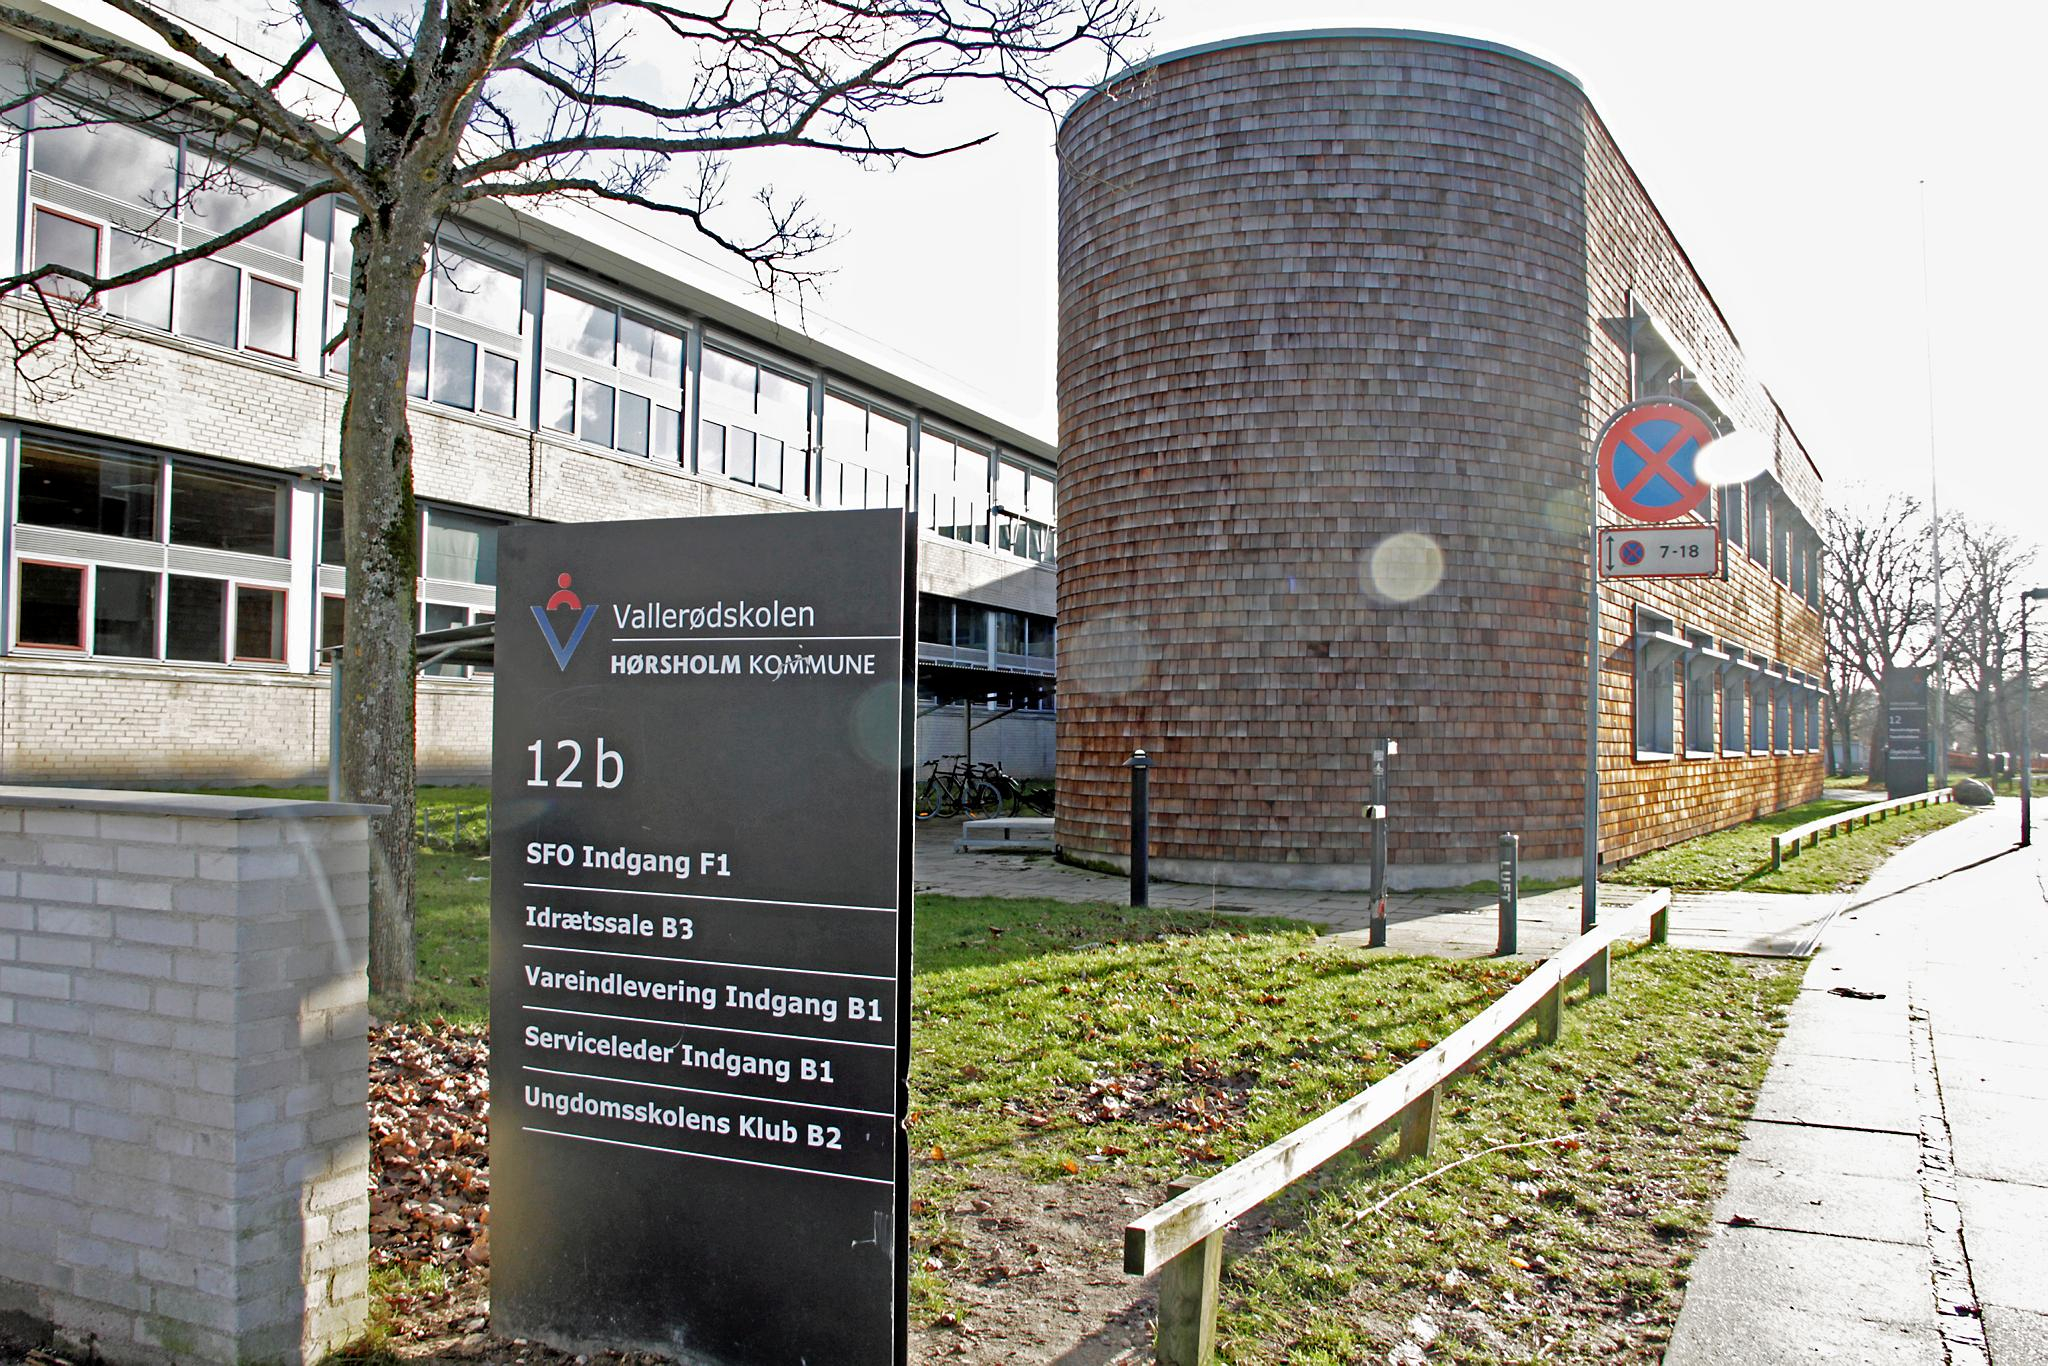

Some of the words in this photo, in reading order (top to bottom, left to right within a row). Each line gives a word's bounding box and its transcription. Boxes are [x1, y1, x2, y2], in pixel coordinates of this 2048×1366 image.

[1659, 544, 1700, 559] 7-18
[612, 600, 815, 630] Vallerødskolen
[610, 654, 742, 676] HØRSHOLM
[749, 653, 876, 675] KOMMUNE
[1889, 716, 1902, 724] 12
[526, 737, 583, 789] 12
[596, 737, 624, 789] b
[526, 842, 575, 868] SFO
[582, 845, 690, 879] Indgang
[700, 852, 731, 877] F1
[1500, 861, 1511, 903] LUFT
[525, 905, 654, 937] Idrætssale
[662, 916, 694, 940] B3
[524, 965, 717, 1010] Vareindlevering
[725, 985, 838, 1023] Indgang
[848, 996, 883, 1022] B1
[525, 1025, 675, 1064] Serviceleder
[681, 1044, 790, 1083] Indgang
[800, 1057, 834, 1083] B1
[524, 1084, 732, 1135] Ungdomsskolens
[739, 1114, 798, 1145] Klub
[807, 1123, 842, 1150] B2
